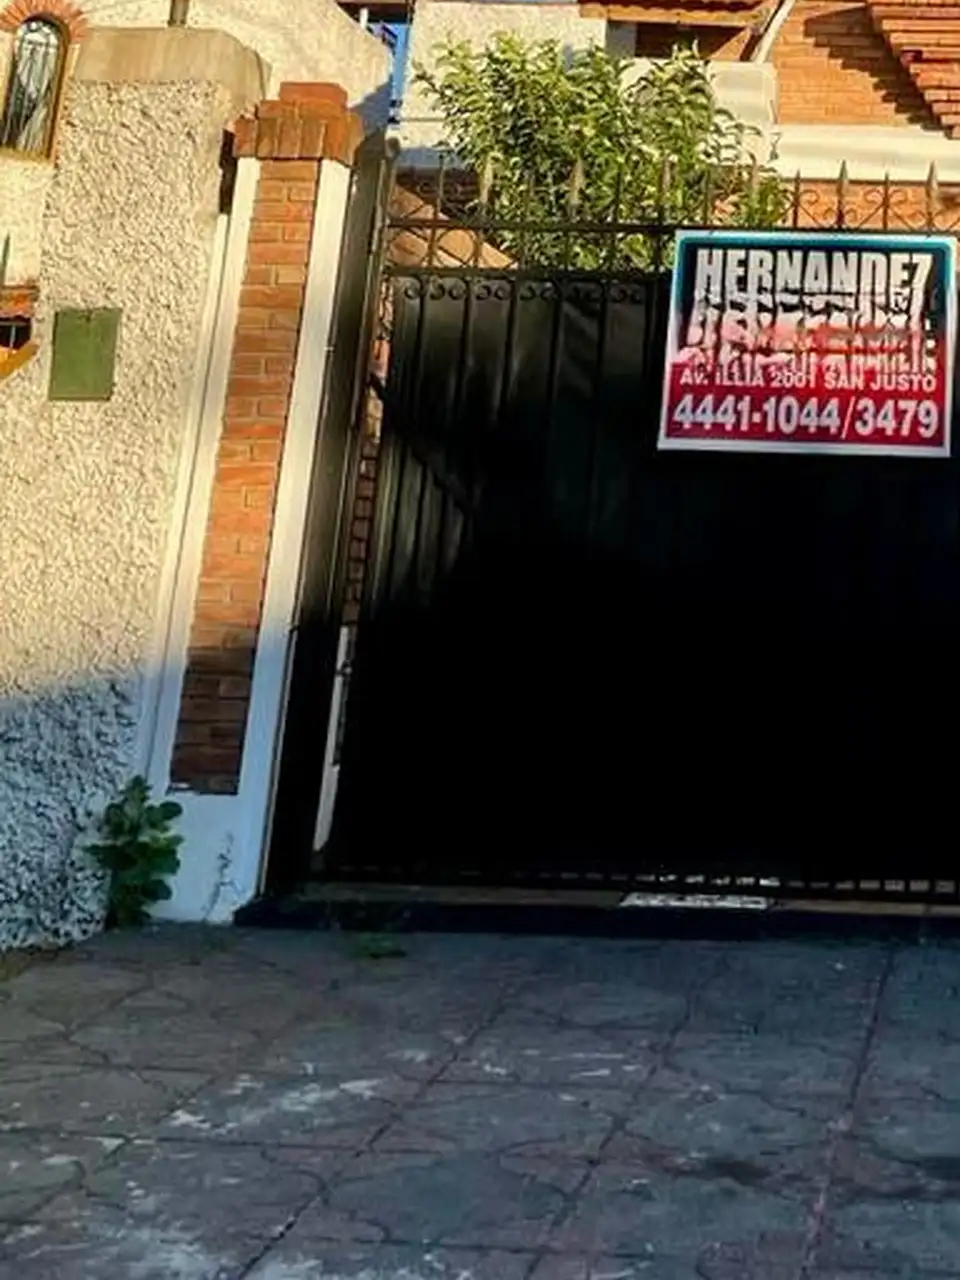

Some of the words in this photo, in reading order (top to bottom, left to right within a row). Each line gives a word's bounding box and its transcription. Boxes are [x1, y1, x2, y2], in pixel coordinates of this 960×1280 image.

[824, 371, 864, 392] SAN
[869, 373, 937, 394] JUSTO
[673, 393, 940, 440] 4441-1044/3479
